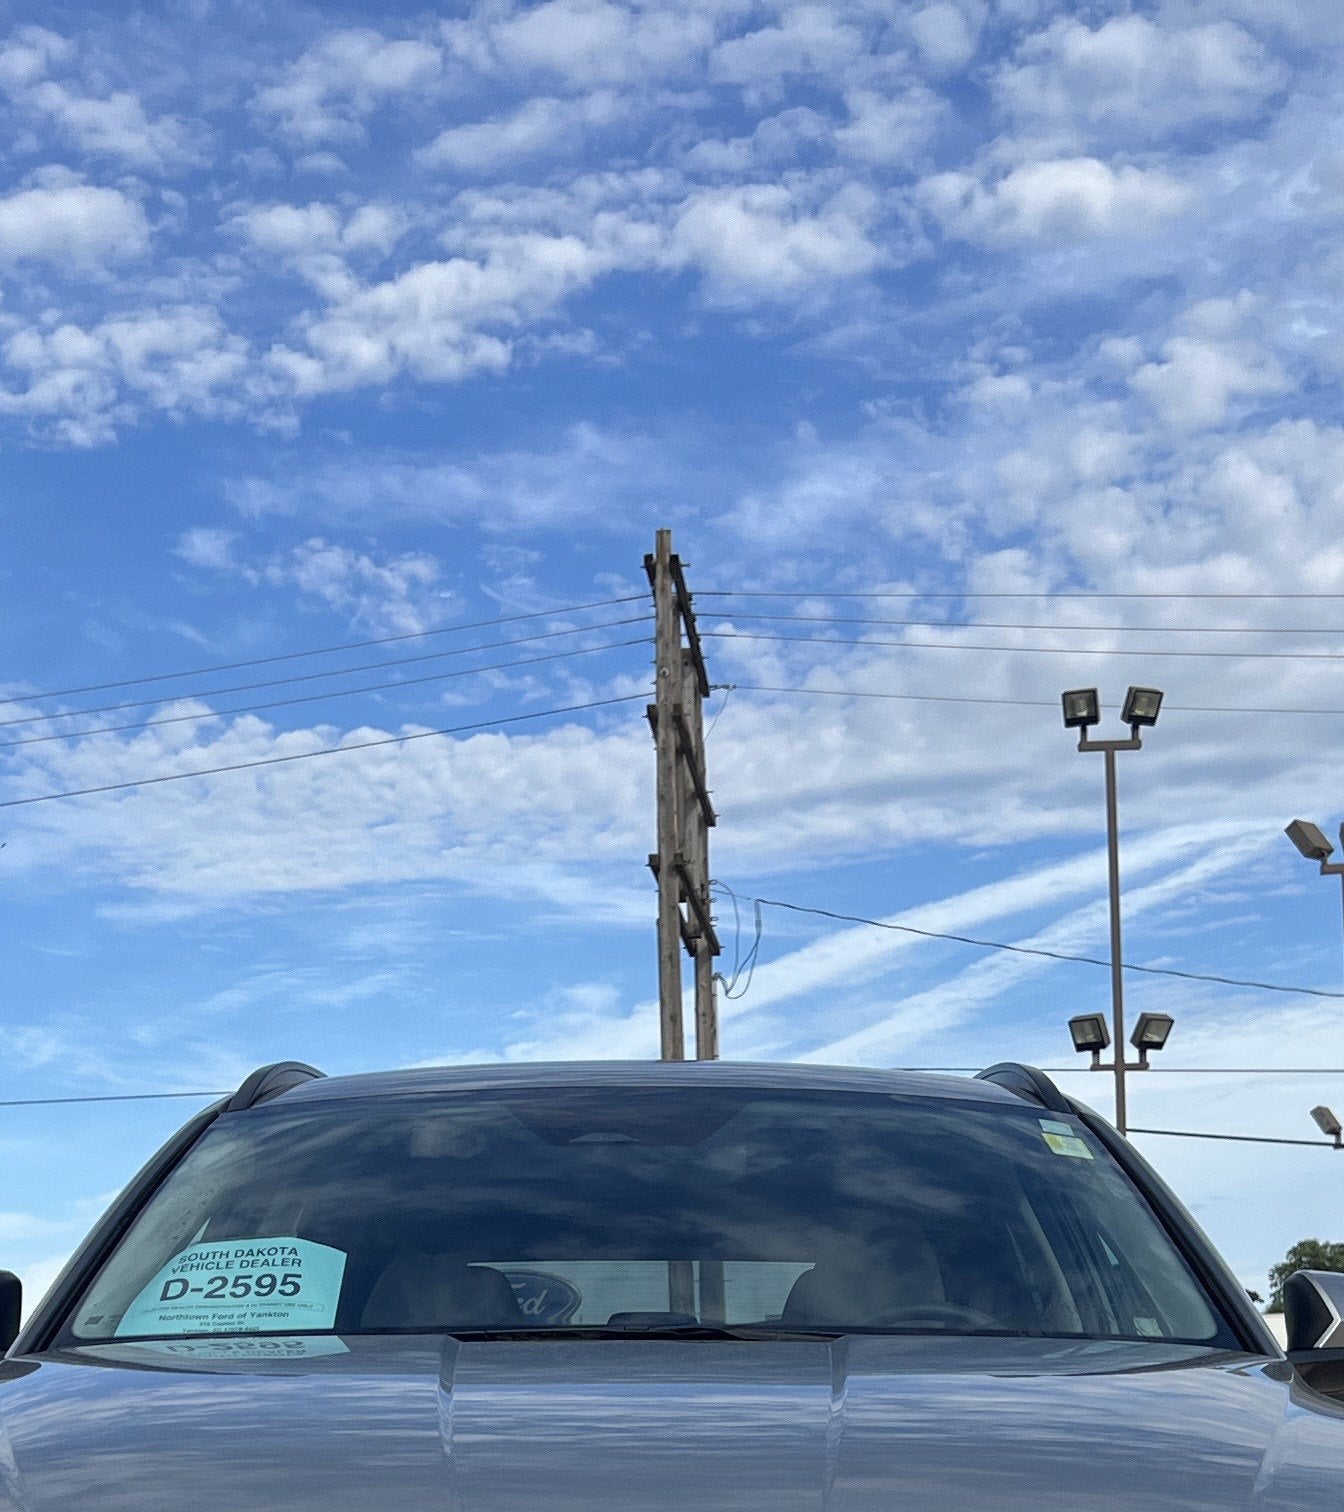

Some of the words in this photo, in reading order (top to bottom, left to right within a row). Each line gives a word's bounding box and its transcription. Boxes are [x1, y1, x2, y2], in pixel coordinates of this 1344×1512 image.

[179, 1250, 230, 1264] SOUTH
[234, 1246, 299, 1259] DAKOTA
[171, 1260, 235, 1274] VEHICLE
[239, 1257, 303, 1270] DEALER
[159, 1272, 303, 1301] D-2595
